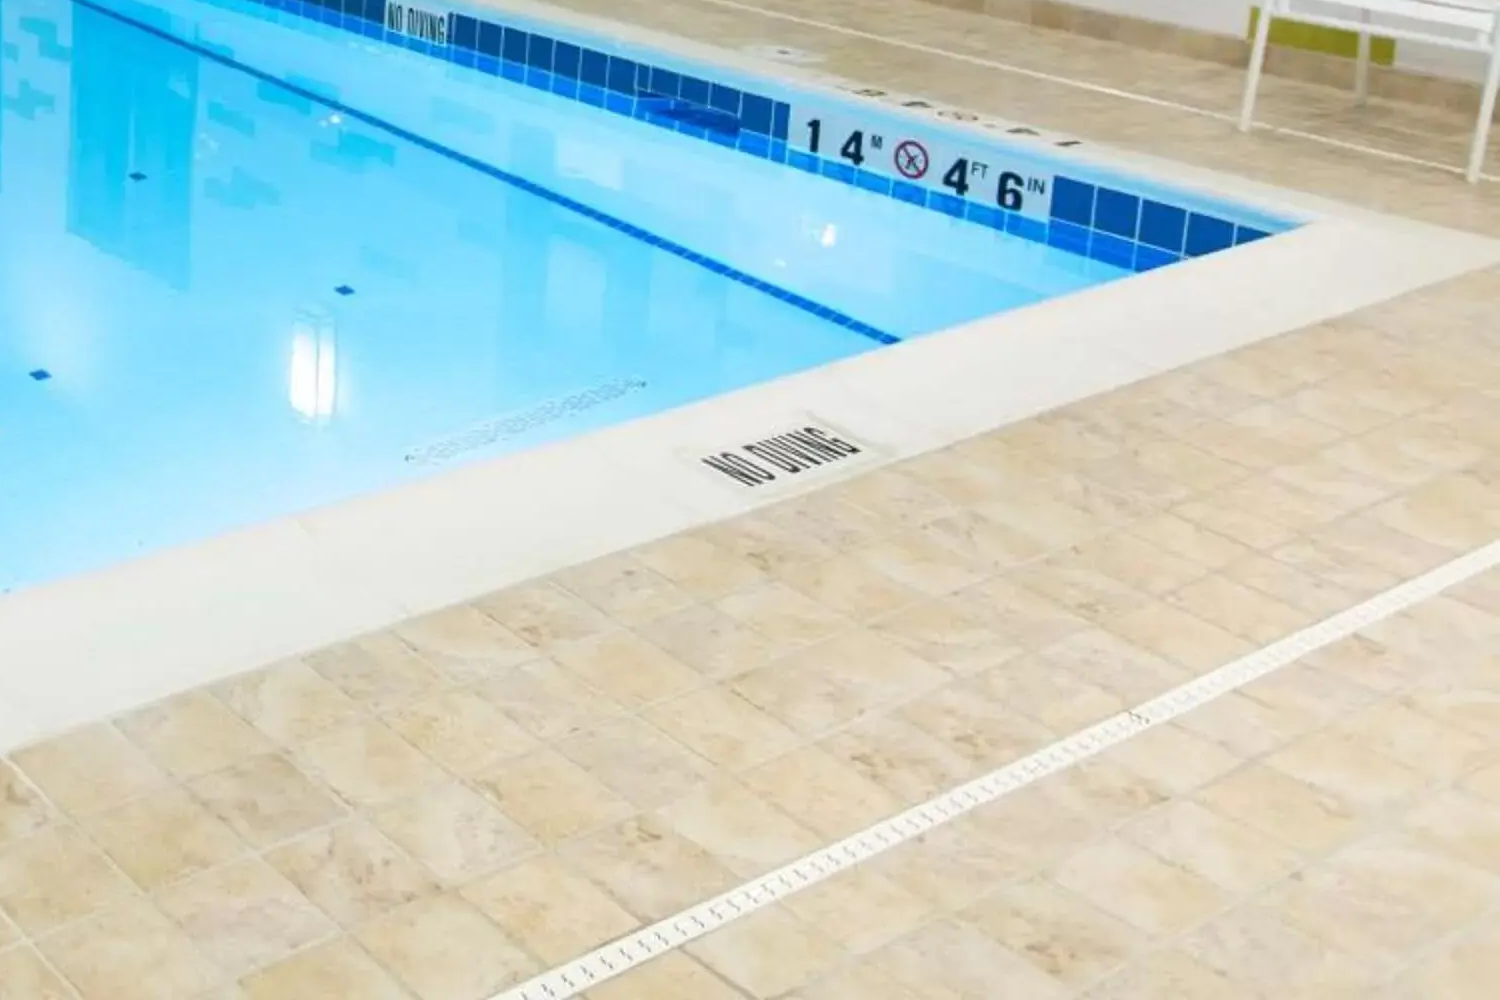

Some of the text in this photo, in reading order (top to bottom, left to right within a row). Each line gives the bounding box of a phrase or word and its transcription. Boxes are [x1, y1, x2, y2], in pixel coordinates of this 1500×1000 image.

[388, 1, 445, 45] NO DIVING
[700, 427, 862, 487] NO DIVING
